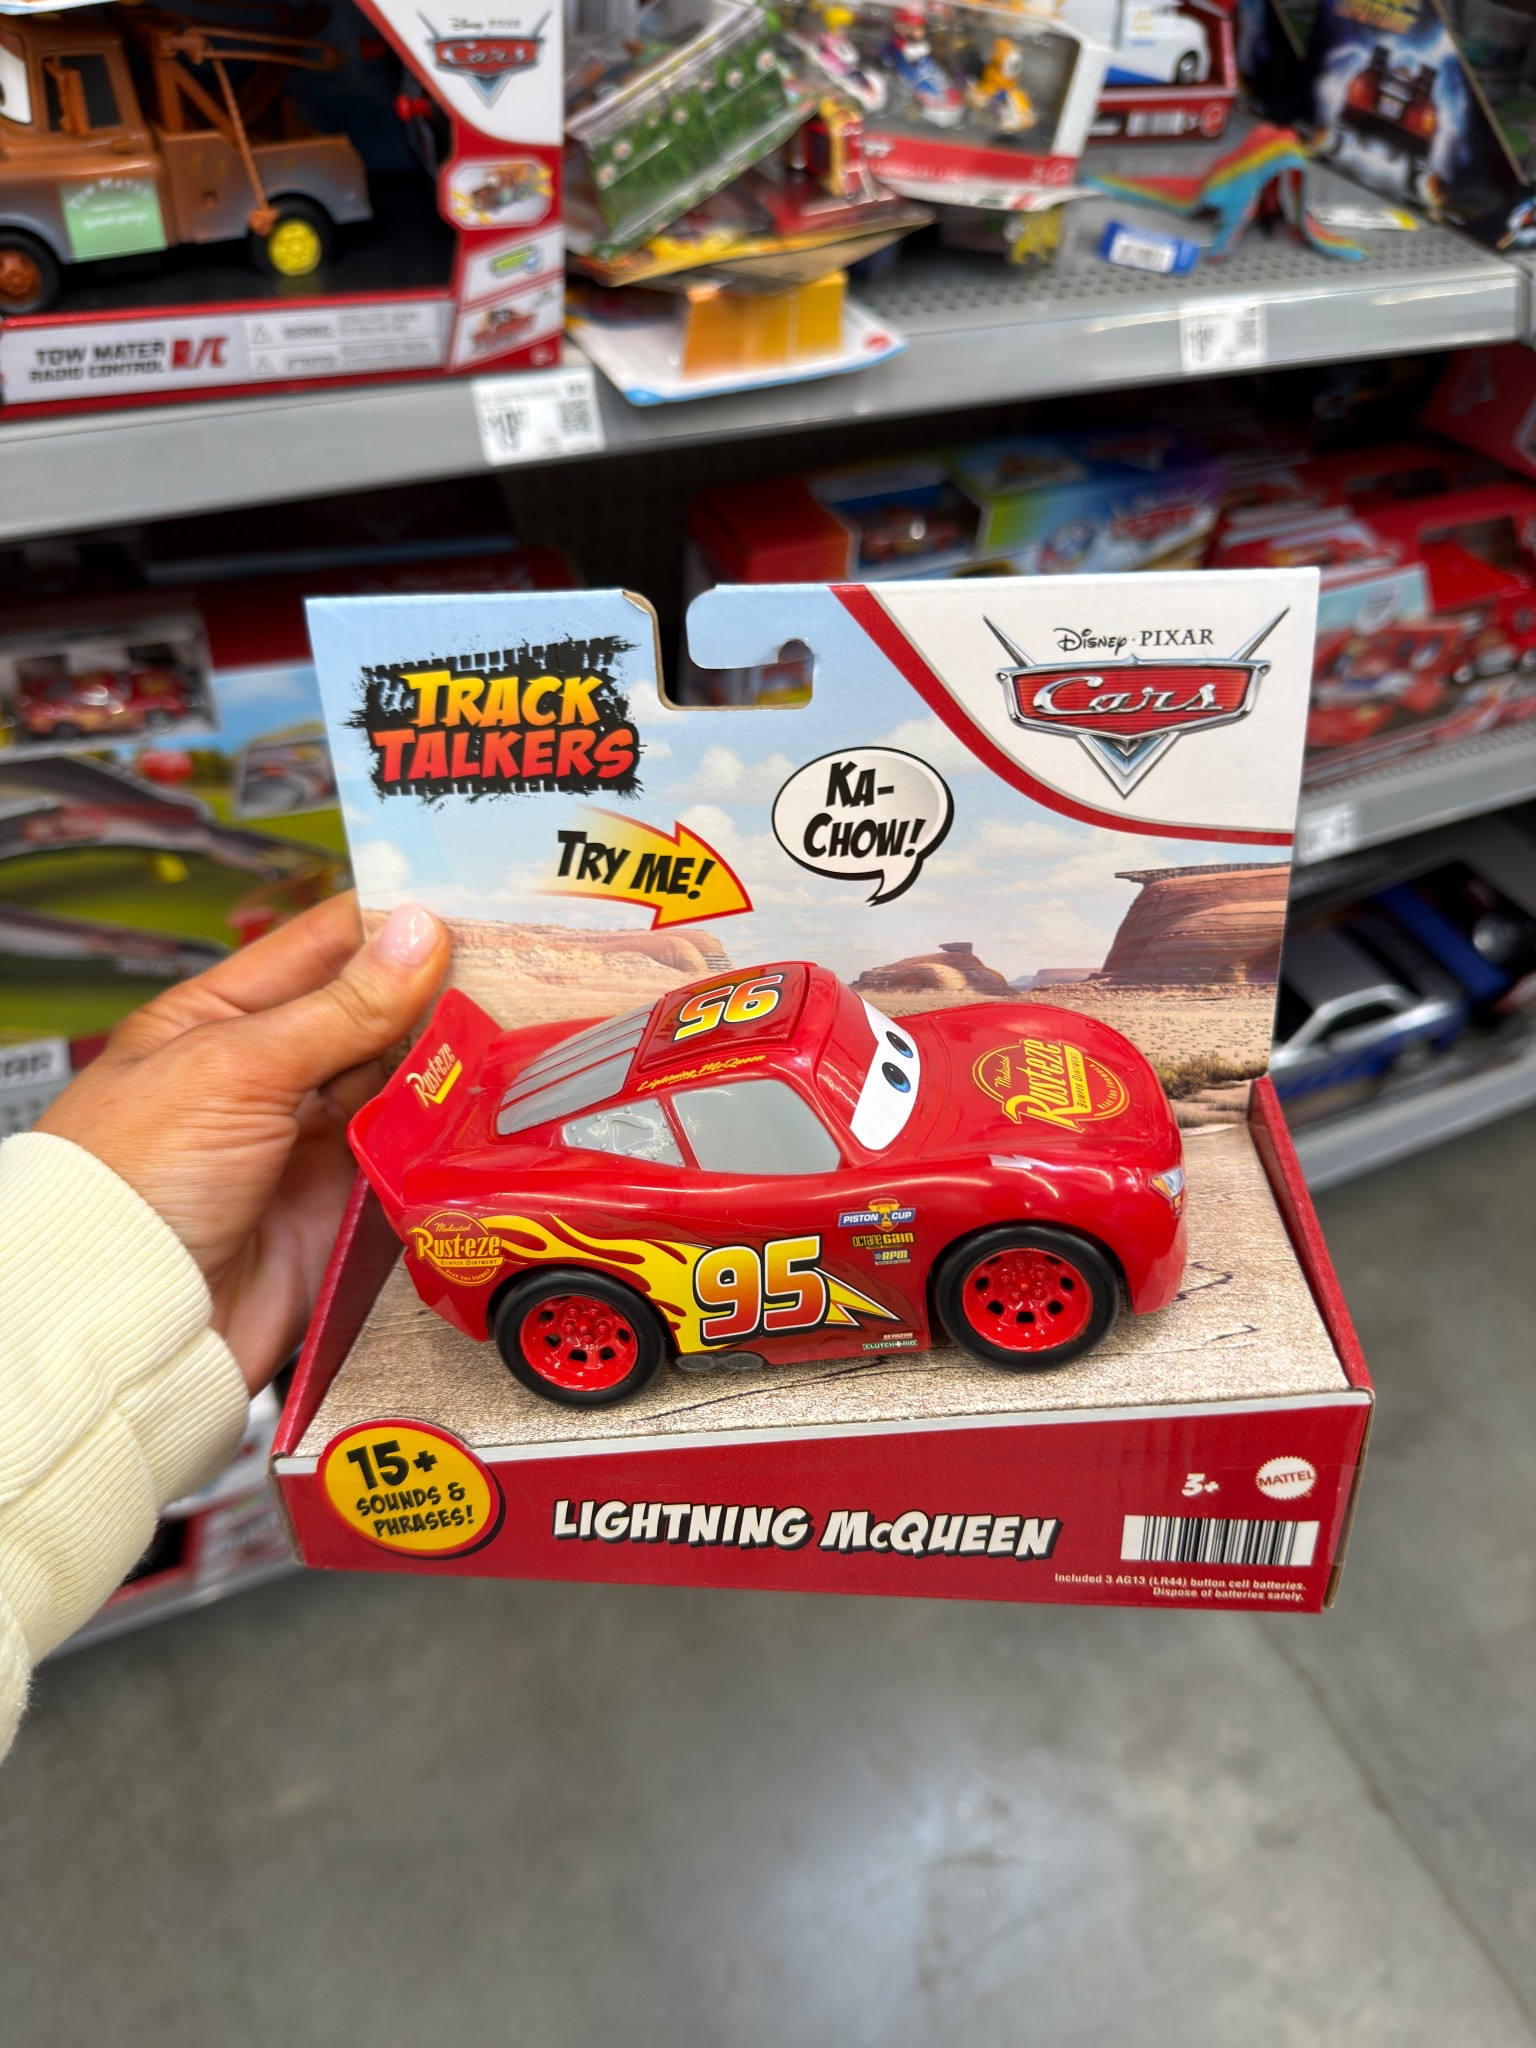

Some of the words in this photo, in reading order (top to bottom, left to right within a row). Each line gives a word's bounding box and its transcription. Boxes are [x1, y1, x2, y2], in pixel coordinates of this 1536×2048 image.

[36, 347, 87, 367] TOW
[94, 341, 165, 362] MATER
[171, 336, 228, 370] R/C
[29, 366, 84, 384] RADIO
[88, 359, 164, 380] CONTROL
[1140, 629, 1214, 647] PIXAR
[400, 670, 603, 728] TRACK
[1033, 676, 1223, 715] Cars
[373, 729, 634, 783] TALKERS
[825, 761, 894, 808] KA-
[803, 813, 927, 858] CHOW!
[557, 830, 631, 884] TRY
[629, 853, 716, 900] ME!
[434, 1222, 473, 1233] Medicated
[843, 1213, 879, 1224] PISTON
[891, 1211, 912, 1220] CUP
[695, 1235, 827, 1340] 95
[346, 1439, 438, 1490] 15+
[1258, 1470, 1315, 1487] MATTEL
[356, 1485, 442, 1517] SOUNDS
[447, 1481, 466, 1501] &
[1181, 1473, 1219, 1497] 3+
[373, 1504, 474, 1538] PHRASES!
[553, 1500, 813, 1549] LIGHTNING
[820, 1509, 1061, 1561] McQUEEN
[1054, 1573, 1102, 1583] Included
[1105, 1575, 1113, 1583] 3
[1116, 1575, 1146, 1584] AG13
[1149, 1576, 1187, 1587] (LR44)
[1190, 1578, 1225, 1588] button
[1228, 1579, 1249, 1588] cell
[1253, 1580, 1306, 1591] batteries.
[1153, 1586, 1197, 1598] Dispose
[1200, 1588, 1212, 1597] of
[1215, 1589, 1264, 1599] batteries
[1267, 1590, 1304, 1602] safely.
